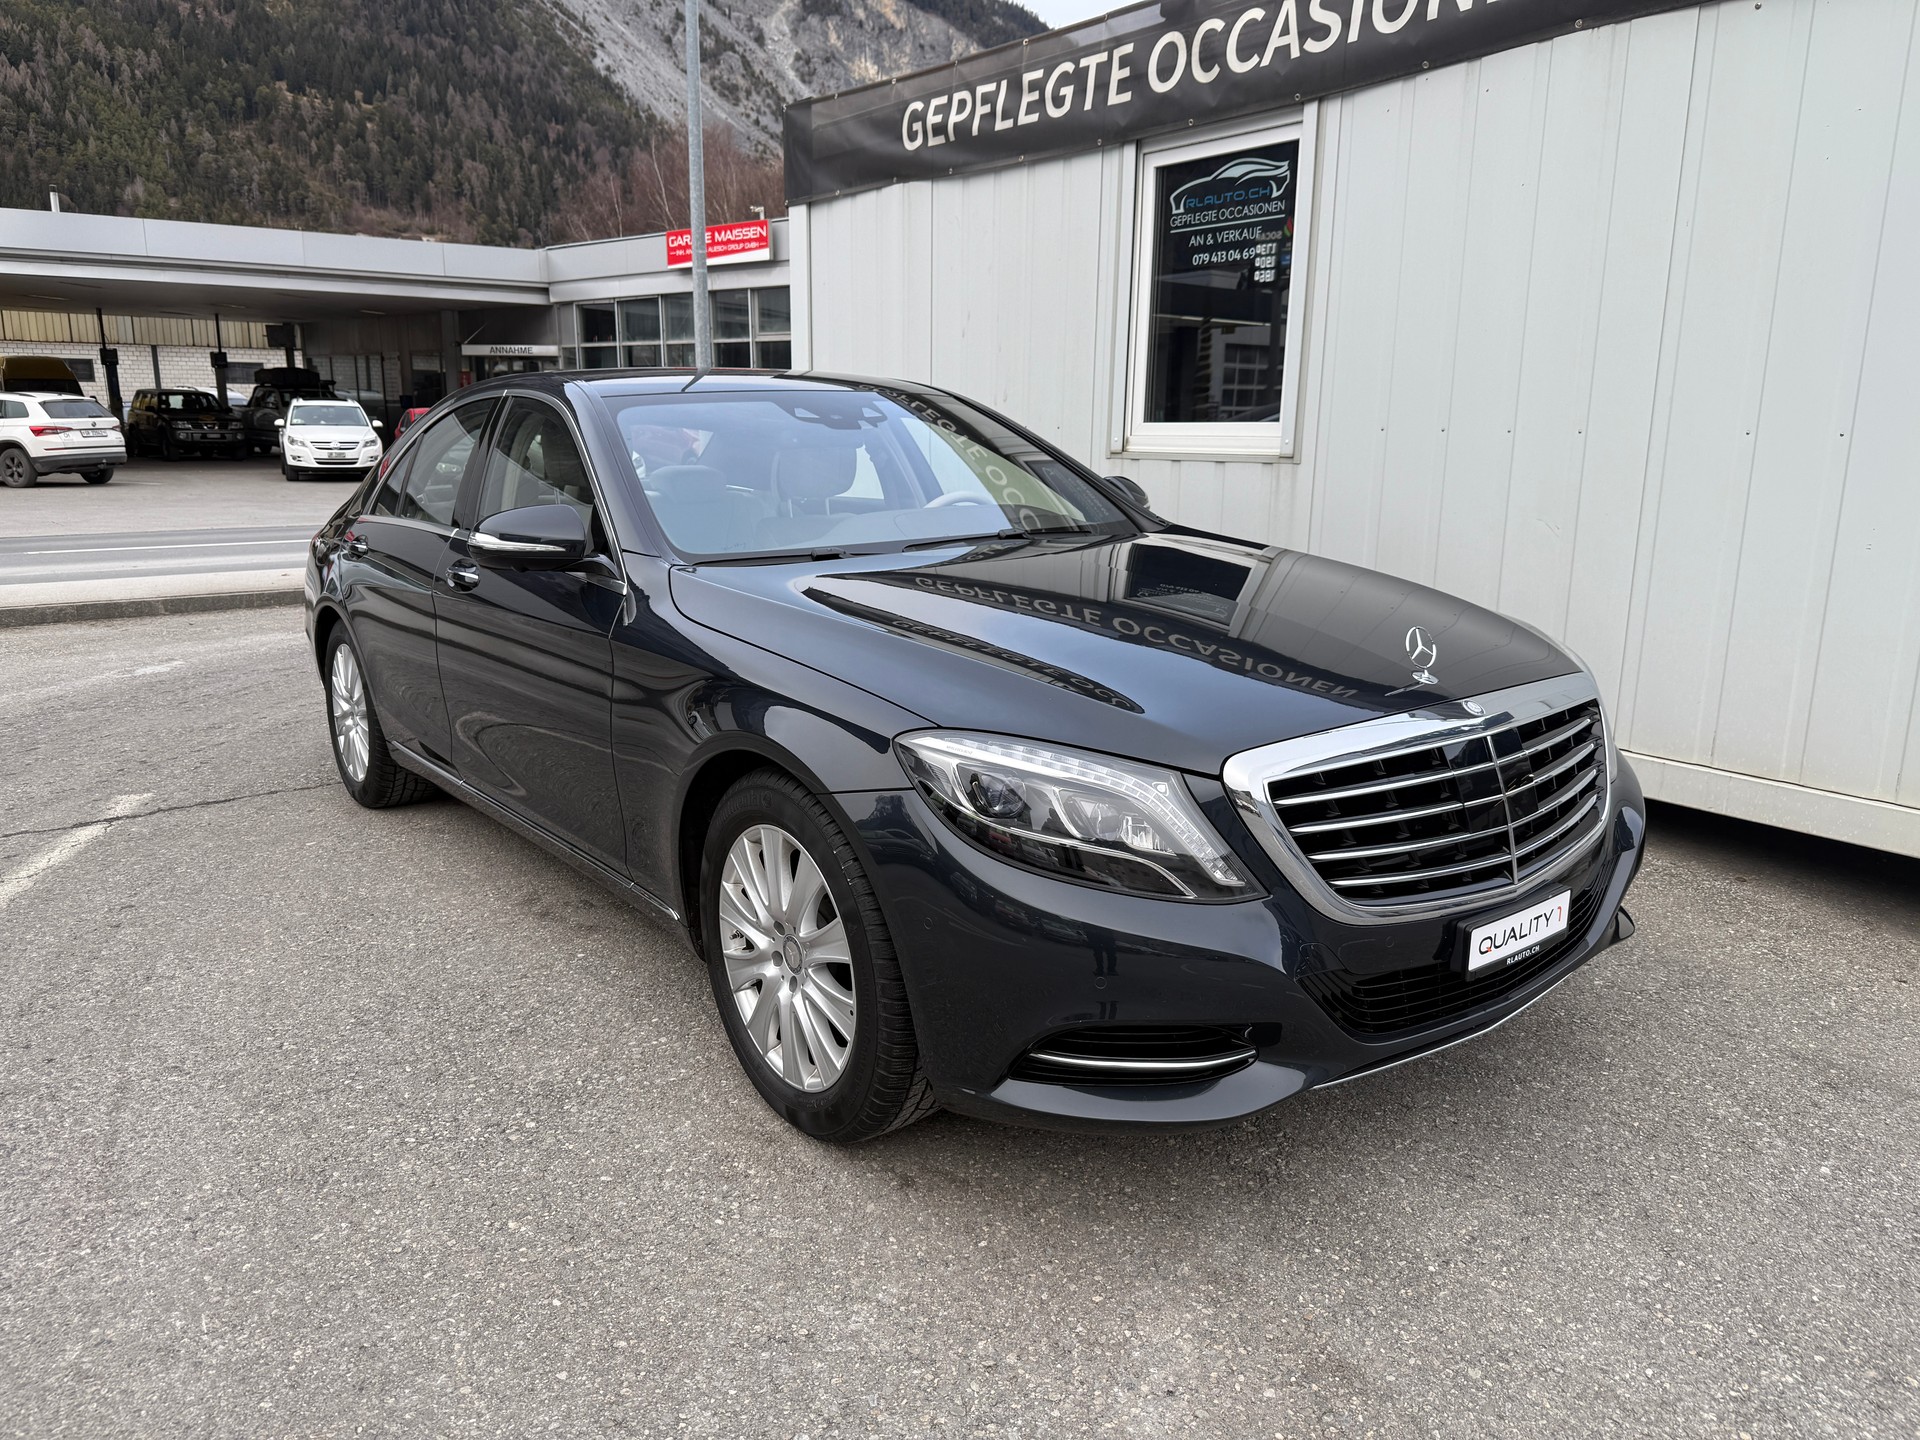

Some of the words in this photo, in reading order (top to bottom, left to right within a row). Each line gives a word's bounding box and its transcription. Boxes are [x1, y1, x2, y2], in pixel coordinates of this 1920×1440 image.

[902, 42, 1134, 151] GEPFLEGTE
[1147, 0, 1503, 93] OCCASIO
[1185, 186, 1270, 208] RLAUTO.CH
[1170, 210, 1218, 227] GEPFLEGTE
[1219, 200, 1285, 220] OCCASIONEN
[668, 232, 712, 247] GARE
[715, 225, 767, 242] MAISSEN
[1188, 233, 1205, 247] AN
[1206, 234, 1214, 245] &
[1216, 226, 1262, 243] VERKAUF
[1192, 253, 1210, 266] 079
[1210, 251, 1227, 264] 413
[1228, 249, 1241, 261] 04
[1243, 248, 1256, 260] 69
[489, 346, 533, 355] ANNAHME
[1478, 908, 1554, 955] QUALITY
[1506, 944, 1540, 965] RLAUTO.CH
